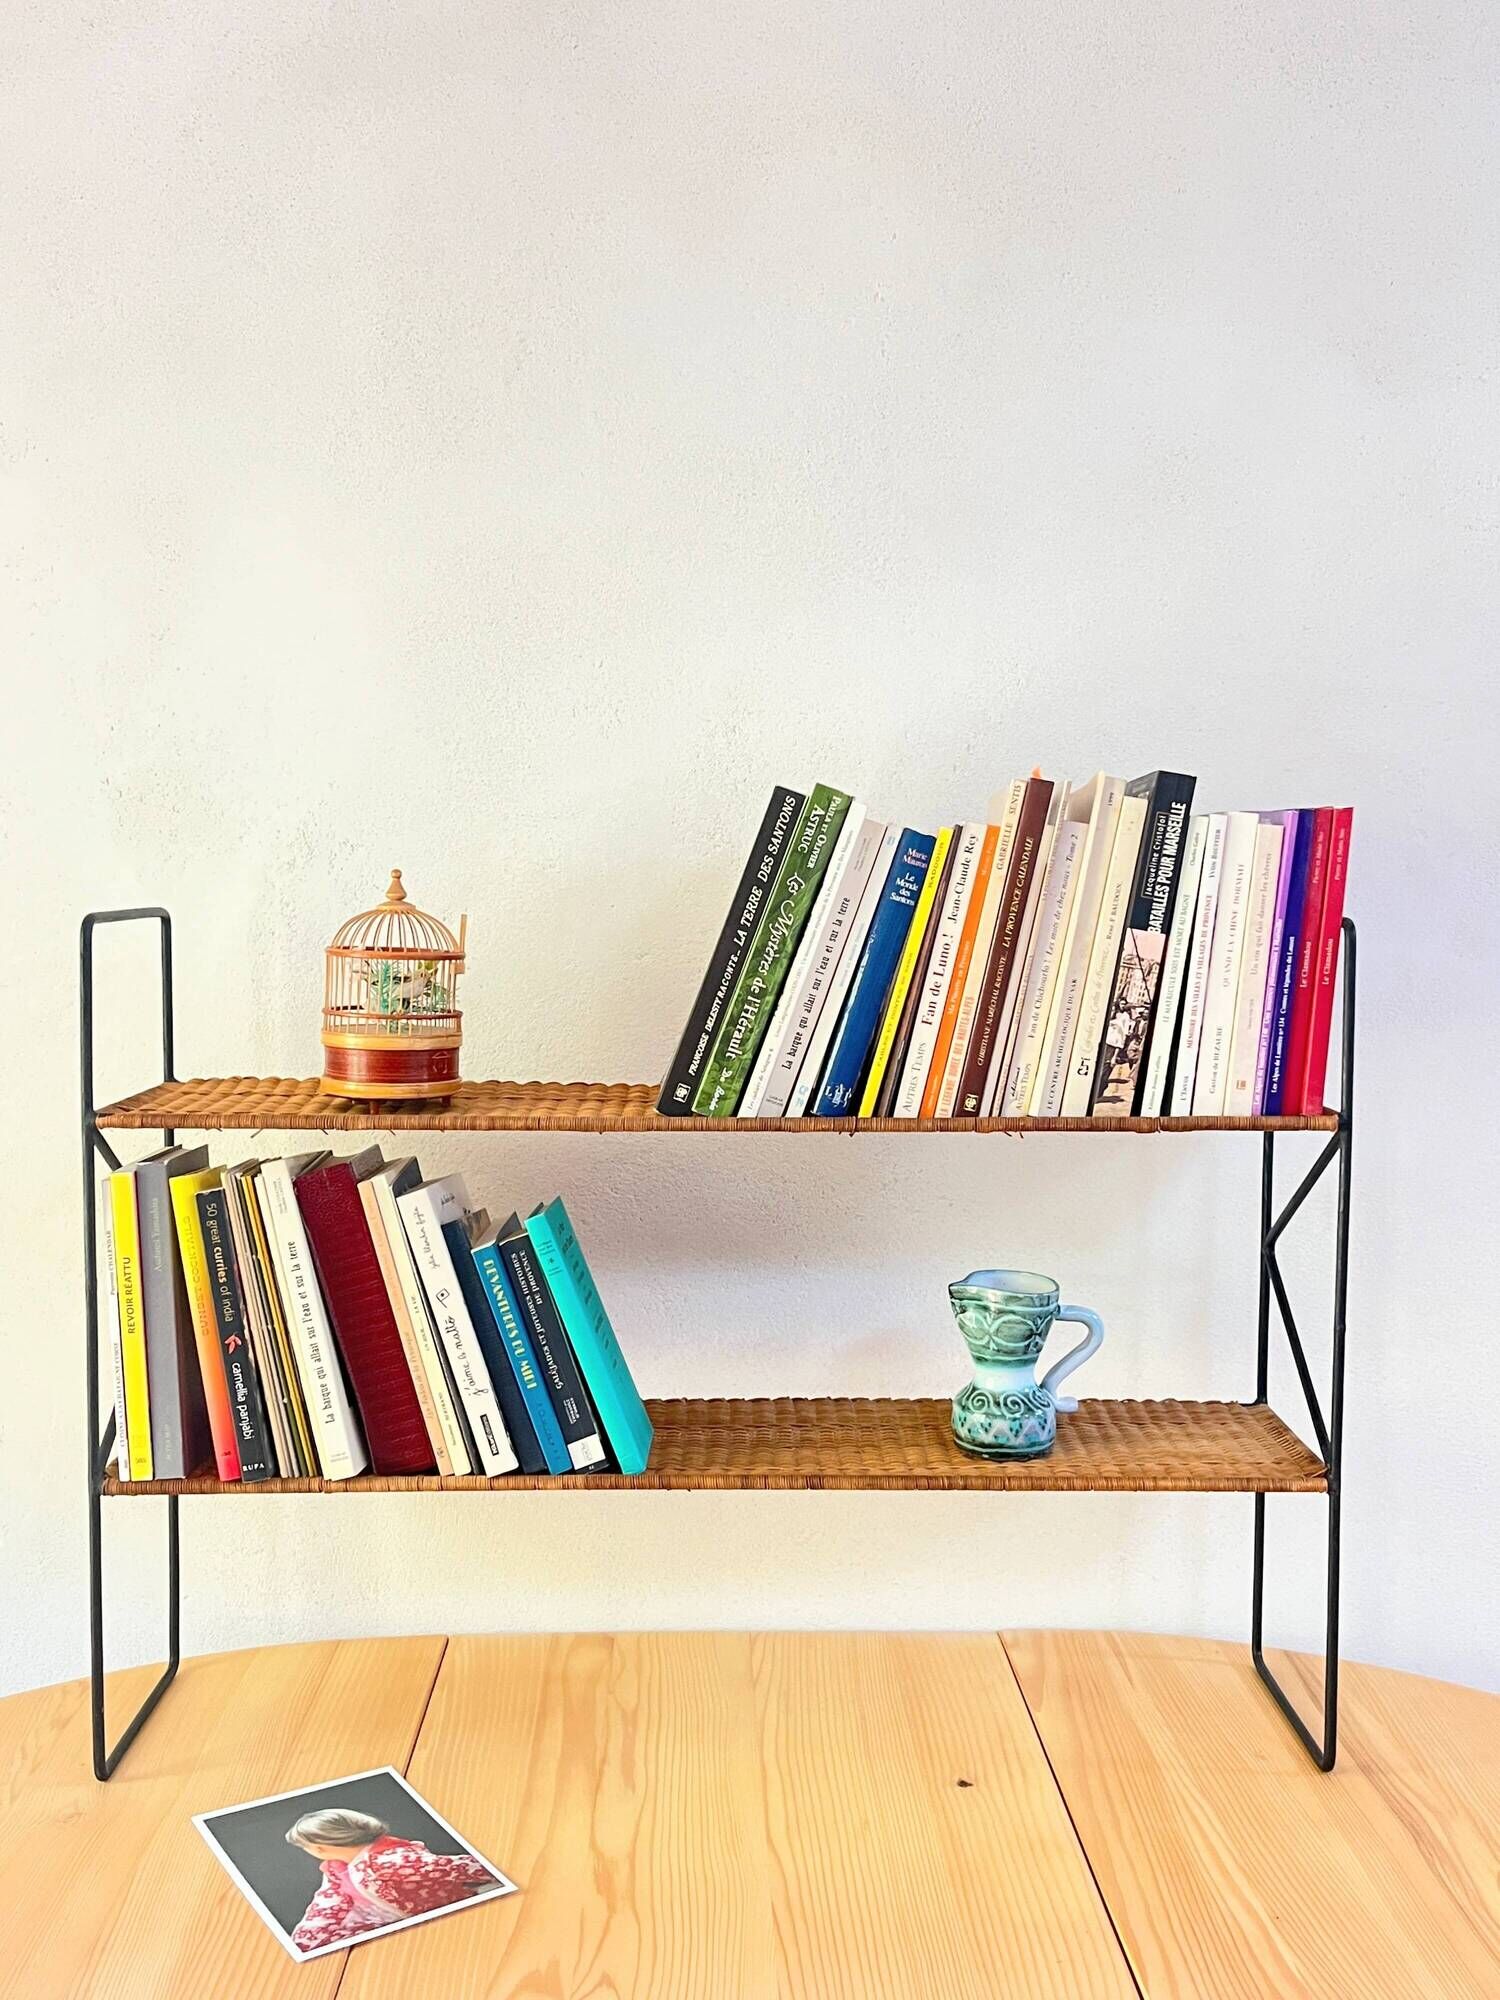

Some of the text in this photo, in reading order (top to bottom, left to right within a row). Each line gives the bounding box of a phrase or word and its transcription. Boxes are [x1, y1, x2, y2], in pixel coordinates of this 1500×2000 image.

[767, 795, 796, 855] SANTONS
[797, 802, 825, 853] ASTRUC
[907, 847, 927, 860] Marie
[995, 823, 1013, 870] GABRIELLE
[1016, 836, 1034, 887] CALENDALE
[1064, 841, 1076, 862] Tome
[756, 854, 774, 882] DES
[786, 871, 806, 896] Les
[895, 876, 918, 891] Monde
[904, 872, 915, 881] Le
[946, 832, 979, 921] Jean-Claude Rey
[1143, 851, 1161, 895] Jacqueline
[1145, 801, 1186, 935] BATAILLES POUR MARSEILLE
[739, 885, 763, 927] TERRE
[889, 891, 914, 906] Santons
[898, 887, 910, 897] des
[1055, 890, 1066, 909] chez
[1004, 888, 1022, 935] PROVENCE
[1052, 909, 1061, 920] de
[733, 929, 747, 947] LA
[757, 899, 795, 976] Mystères
[1001, 936, 1011, 948] LA
[932, 942, 951, 977] Luno
[750, 976, 766, 993] de
[780, 897, 850, 1070] La barque qui allait sur l'eau et sur la terre
[928, 984, 941, 996] de
[1299, 978, 1307, 987] Le
[1321, 975, 1329, 984] Le
[704, 996, 722, 1032] DELESTY
[725, 995, 761, 1059] l'Hérault
[920, 1000, 937, 1025] Fan
[1031, 1012, 1040, 1021] de
[1026, 1022, 1037, 1038] Fan
[977, 1026, 991, 1066] CHRISTIANE
[719, 1066, 733, 1082] De
[901, 1042, 926, 1112] AUTRES TEMPS
[1212, 1062, 1218, 1070] de
[1271, 1066, 1280, 1082] Alpes
[205, 1202, 235, 1322] 50 great curries of india
[518, 1249, 543, 1305] DE PROVENCE
[122, 1256, 135, 1334] REVOIR RÉATTU
[287, 1241, 335, 1424] La barque qui allait sur l'eau et sur la terre
[483, 1259, 537, 1389] DEVANTURES DU MIDI
[537, 1334, 547, 1345] ET
[462, 1360, 489, 1396] j'aime
[231, 1362, 254, 1440] camellia panjabi
